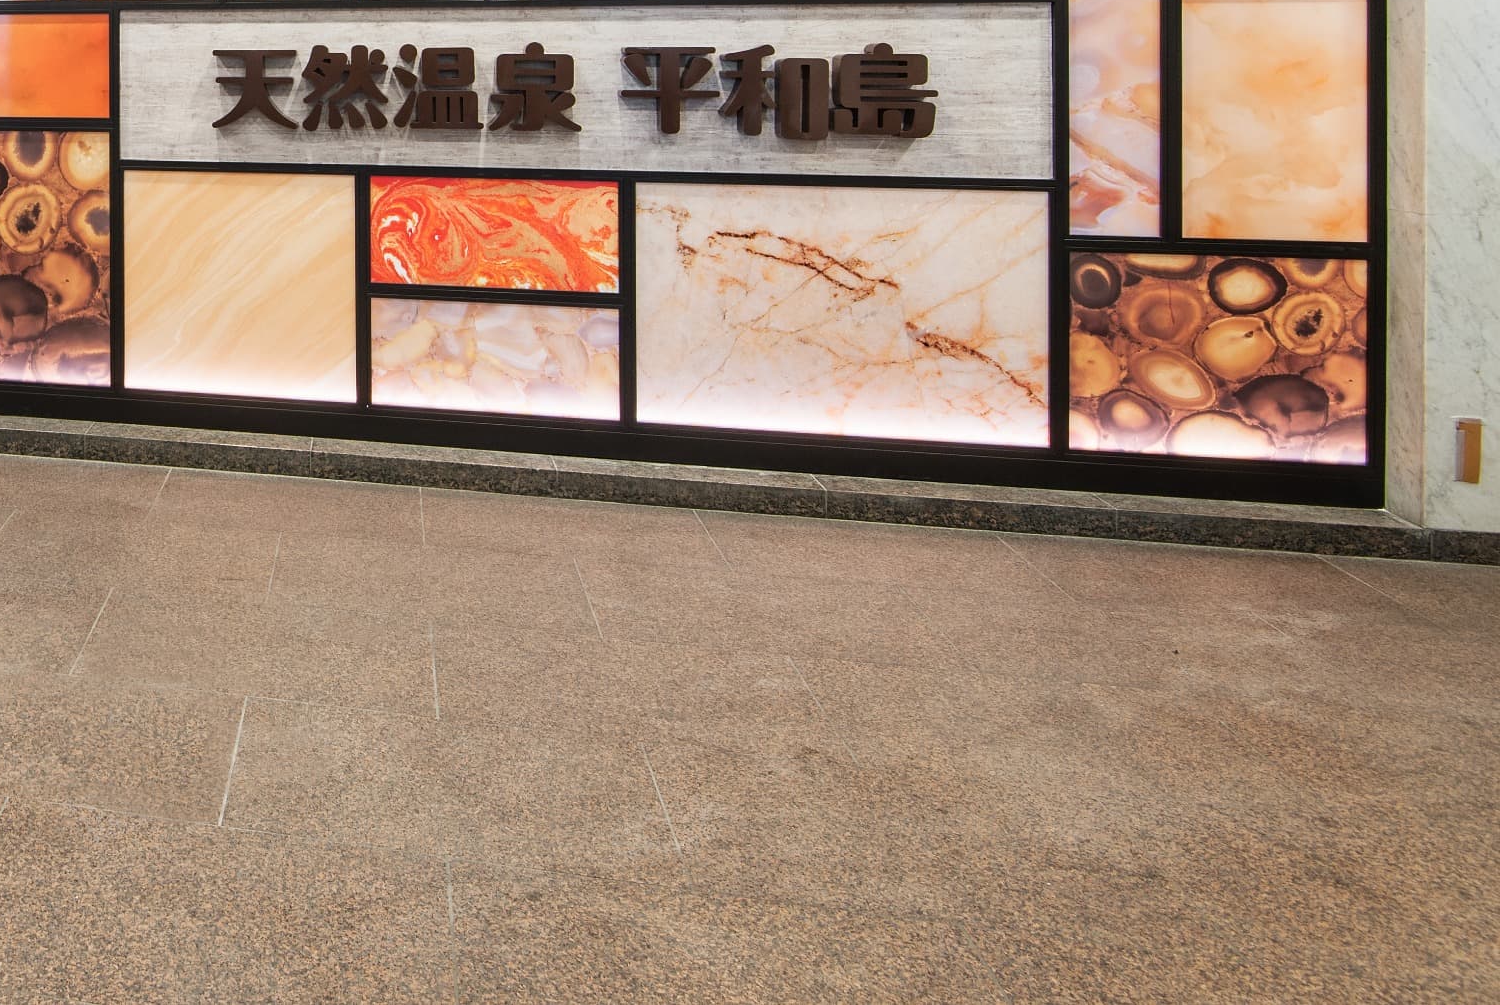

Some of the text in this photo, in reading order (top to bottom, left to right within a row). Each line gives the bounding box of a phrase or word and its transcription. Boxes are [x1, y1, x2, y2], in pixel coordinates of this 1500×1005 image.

[212, 42, 939, 140] 天然温泉 平和島
